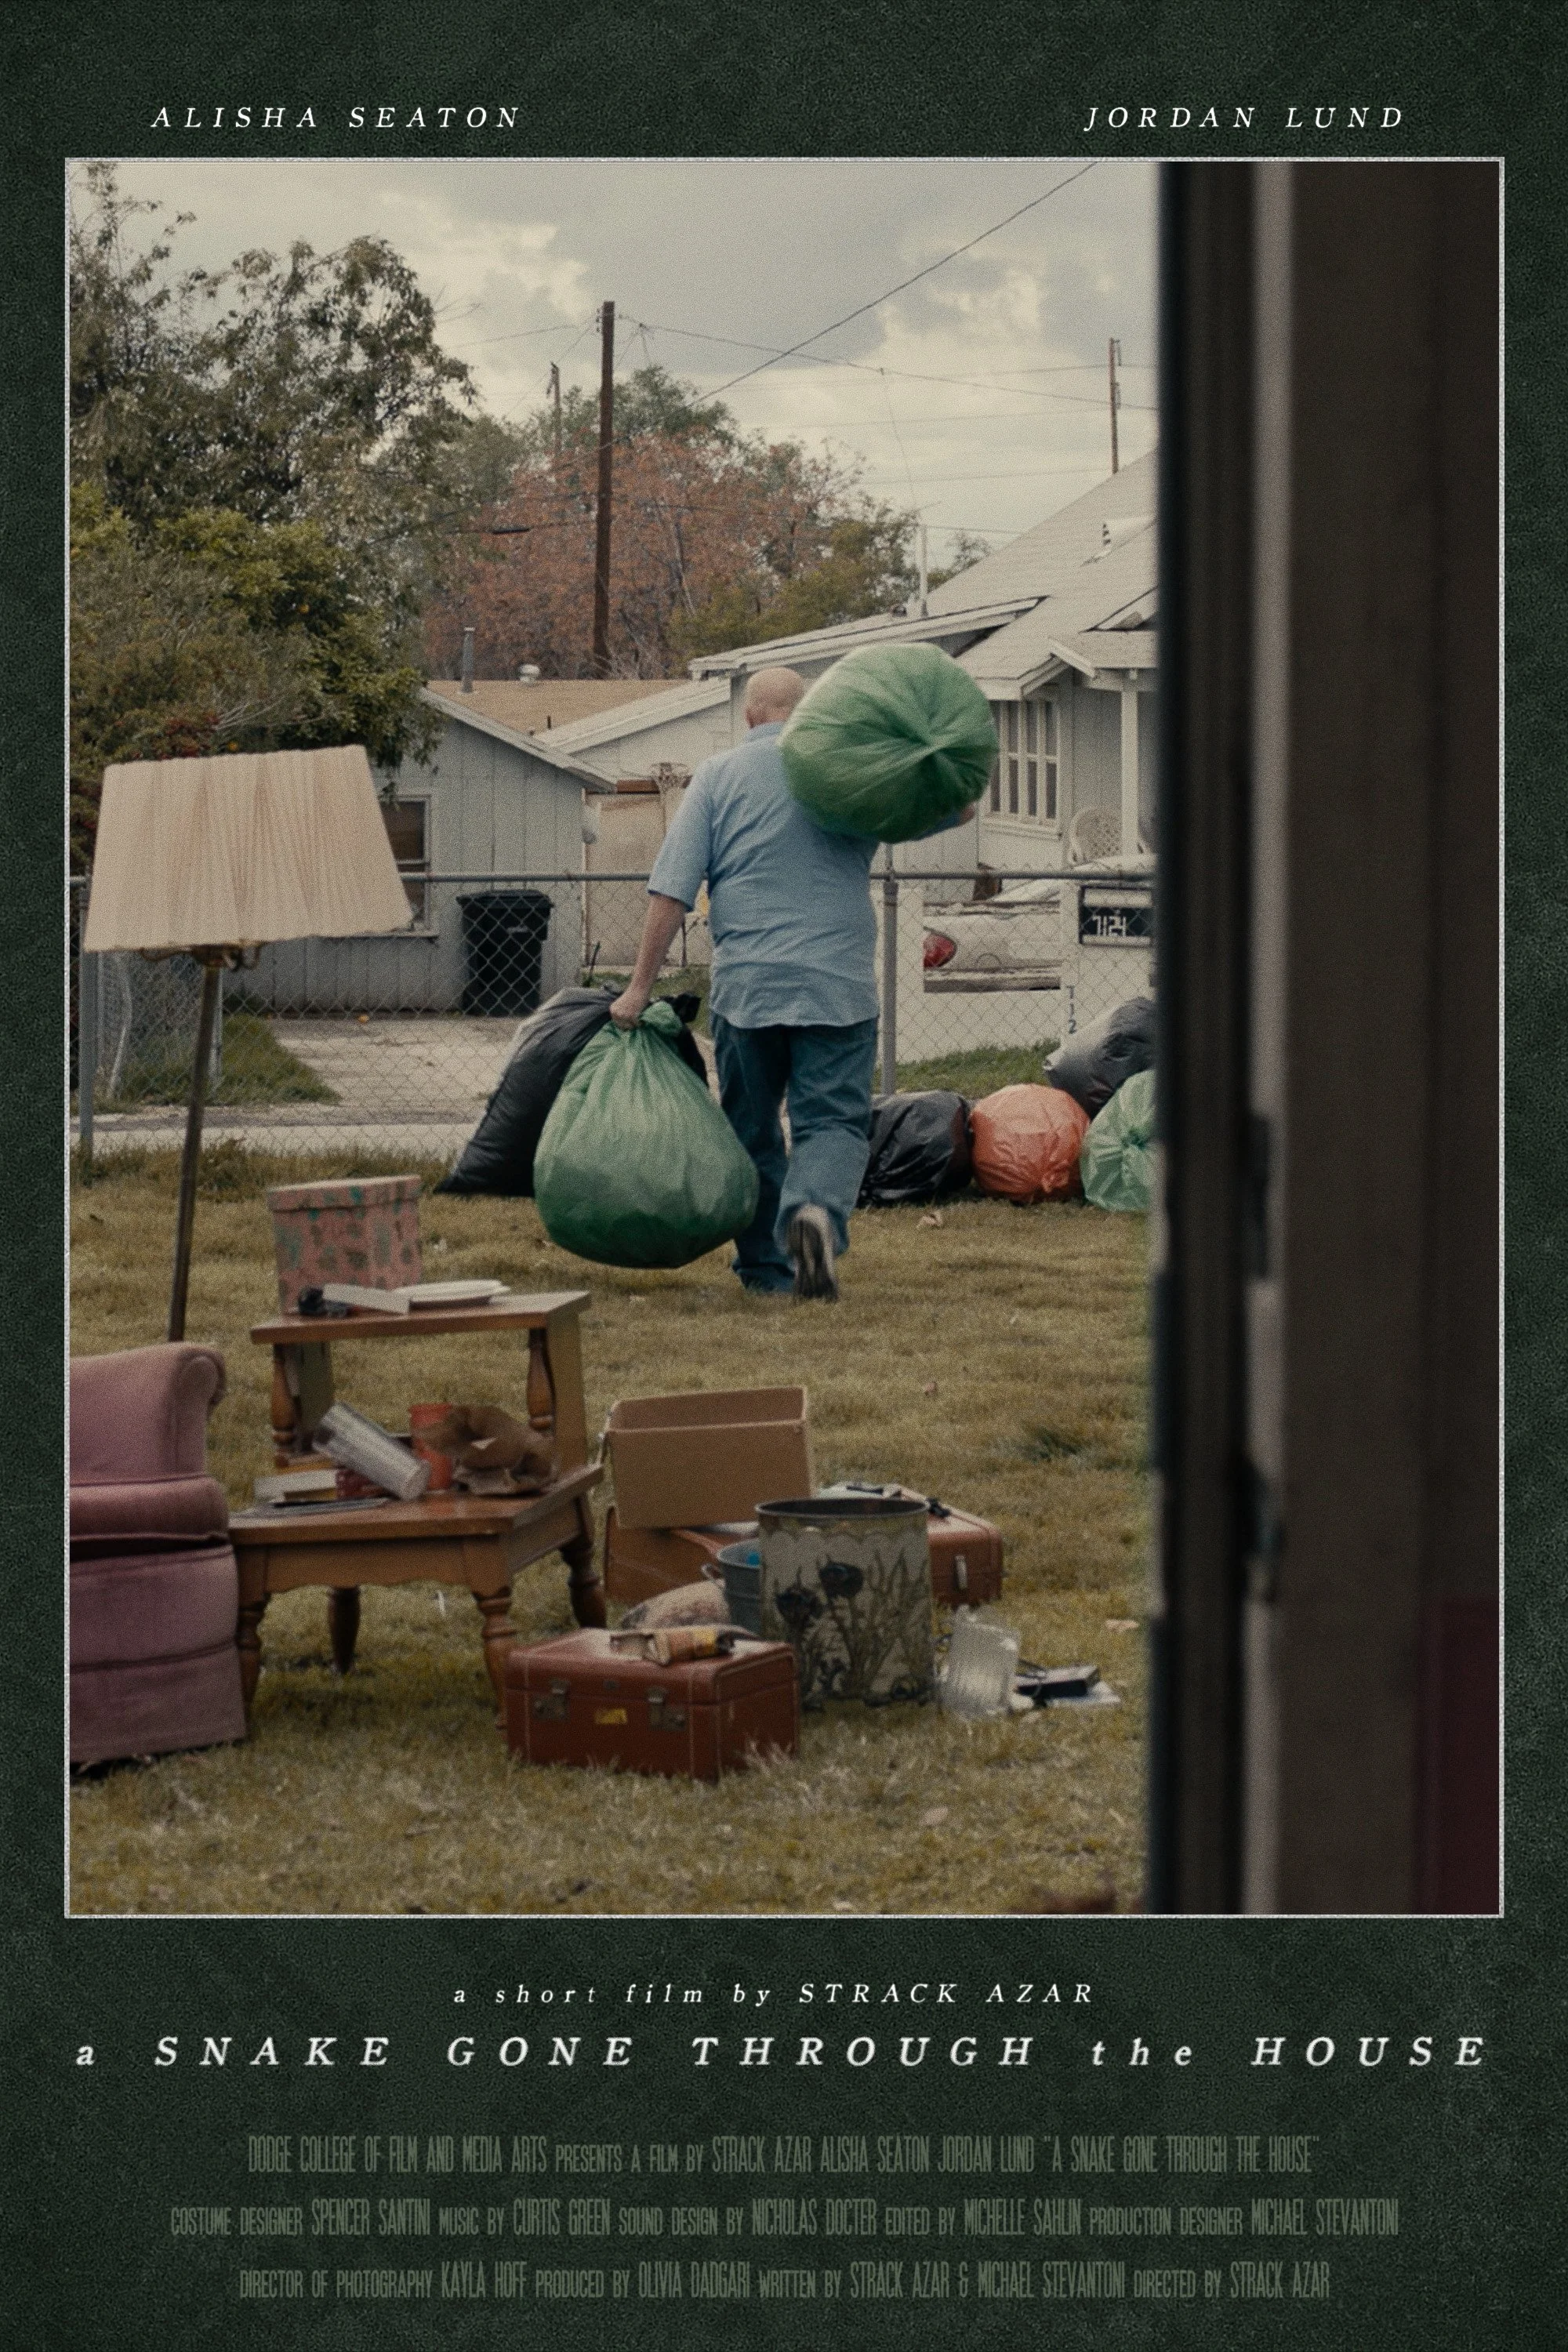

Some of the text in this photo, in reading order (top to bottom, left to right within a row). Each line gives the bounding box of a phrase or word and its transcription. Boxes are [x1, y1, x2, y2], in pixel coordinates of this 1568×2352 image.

[151, 107, 518, 128] ALISHA SEATON
[1083, 107, 1402, 132] JORDAN LUND
[453, 1983, 1091, 2007] a short film by STRACK AZAR
[76, 2036, 1483, 2067] a SNAKE GONE THROUGH the HOUSE
[249, 2135, 292, 2172] DODGE
[299, 2135, 357, 2172] COLLEGE
[364, 2135, 382, 2172] OF
[389, 2135, 418, 2172] FILM
[426, 2135, 455, 2172] AND
[462, 2135, 503, 2172] MEDIA
[511, 2135, 547, 2172] ARTS
[555, 2143, 622, 2173] PRESENTS
[630, 2144, 641, 2172] A
[649, 2144, 679, 2172] FILM
[686, 2144, 704, 2172] BY
[712, 2135, 765, 2173] STRACK
[774, 2135, 811, 2172] AZAR
[820, 2135, 869, 2173] ALISHA
[877, 2135, 930, 2173] SEATON
[937, 2135, 992, 2172] JORDAN
[1000, 2135, 1035, 2172] LUND
[1071, 2135, 1115, 2172] SNAKE
[1123, 2135, 1158, 2172] GONE
[1166, 2135, 1228, 2173] THROUGH
[1235, 2135, 1261, 2172] THE
[170, 2198, 1399, 2236] COSTUME DESIGNER SPENCER SANTINI MUSIC BY CURTIS GREEN SOUND DESIGN BY NICHOLAS DOCTER EDITED BY MICHELLE SAHLIN PRODUCTION DESIGNER MICHAEL STEVANTONI
[239, 2260, 1330, 2299] DIRECTOR OF PHOTOGRAPHY KAYLA HOFF PRODUCED BY OLIVIA DADGARI WRITTEN BY STRACK AZAR & MICHAEL STEVANTONI DIRECTED BY STRACK AZAR
